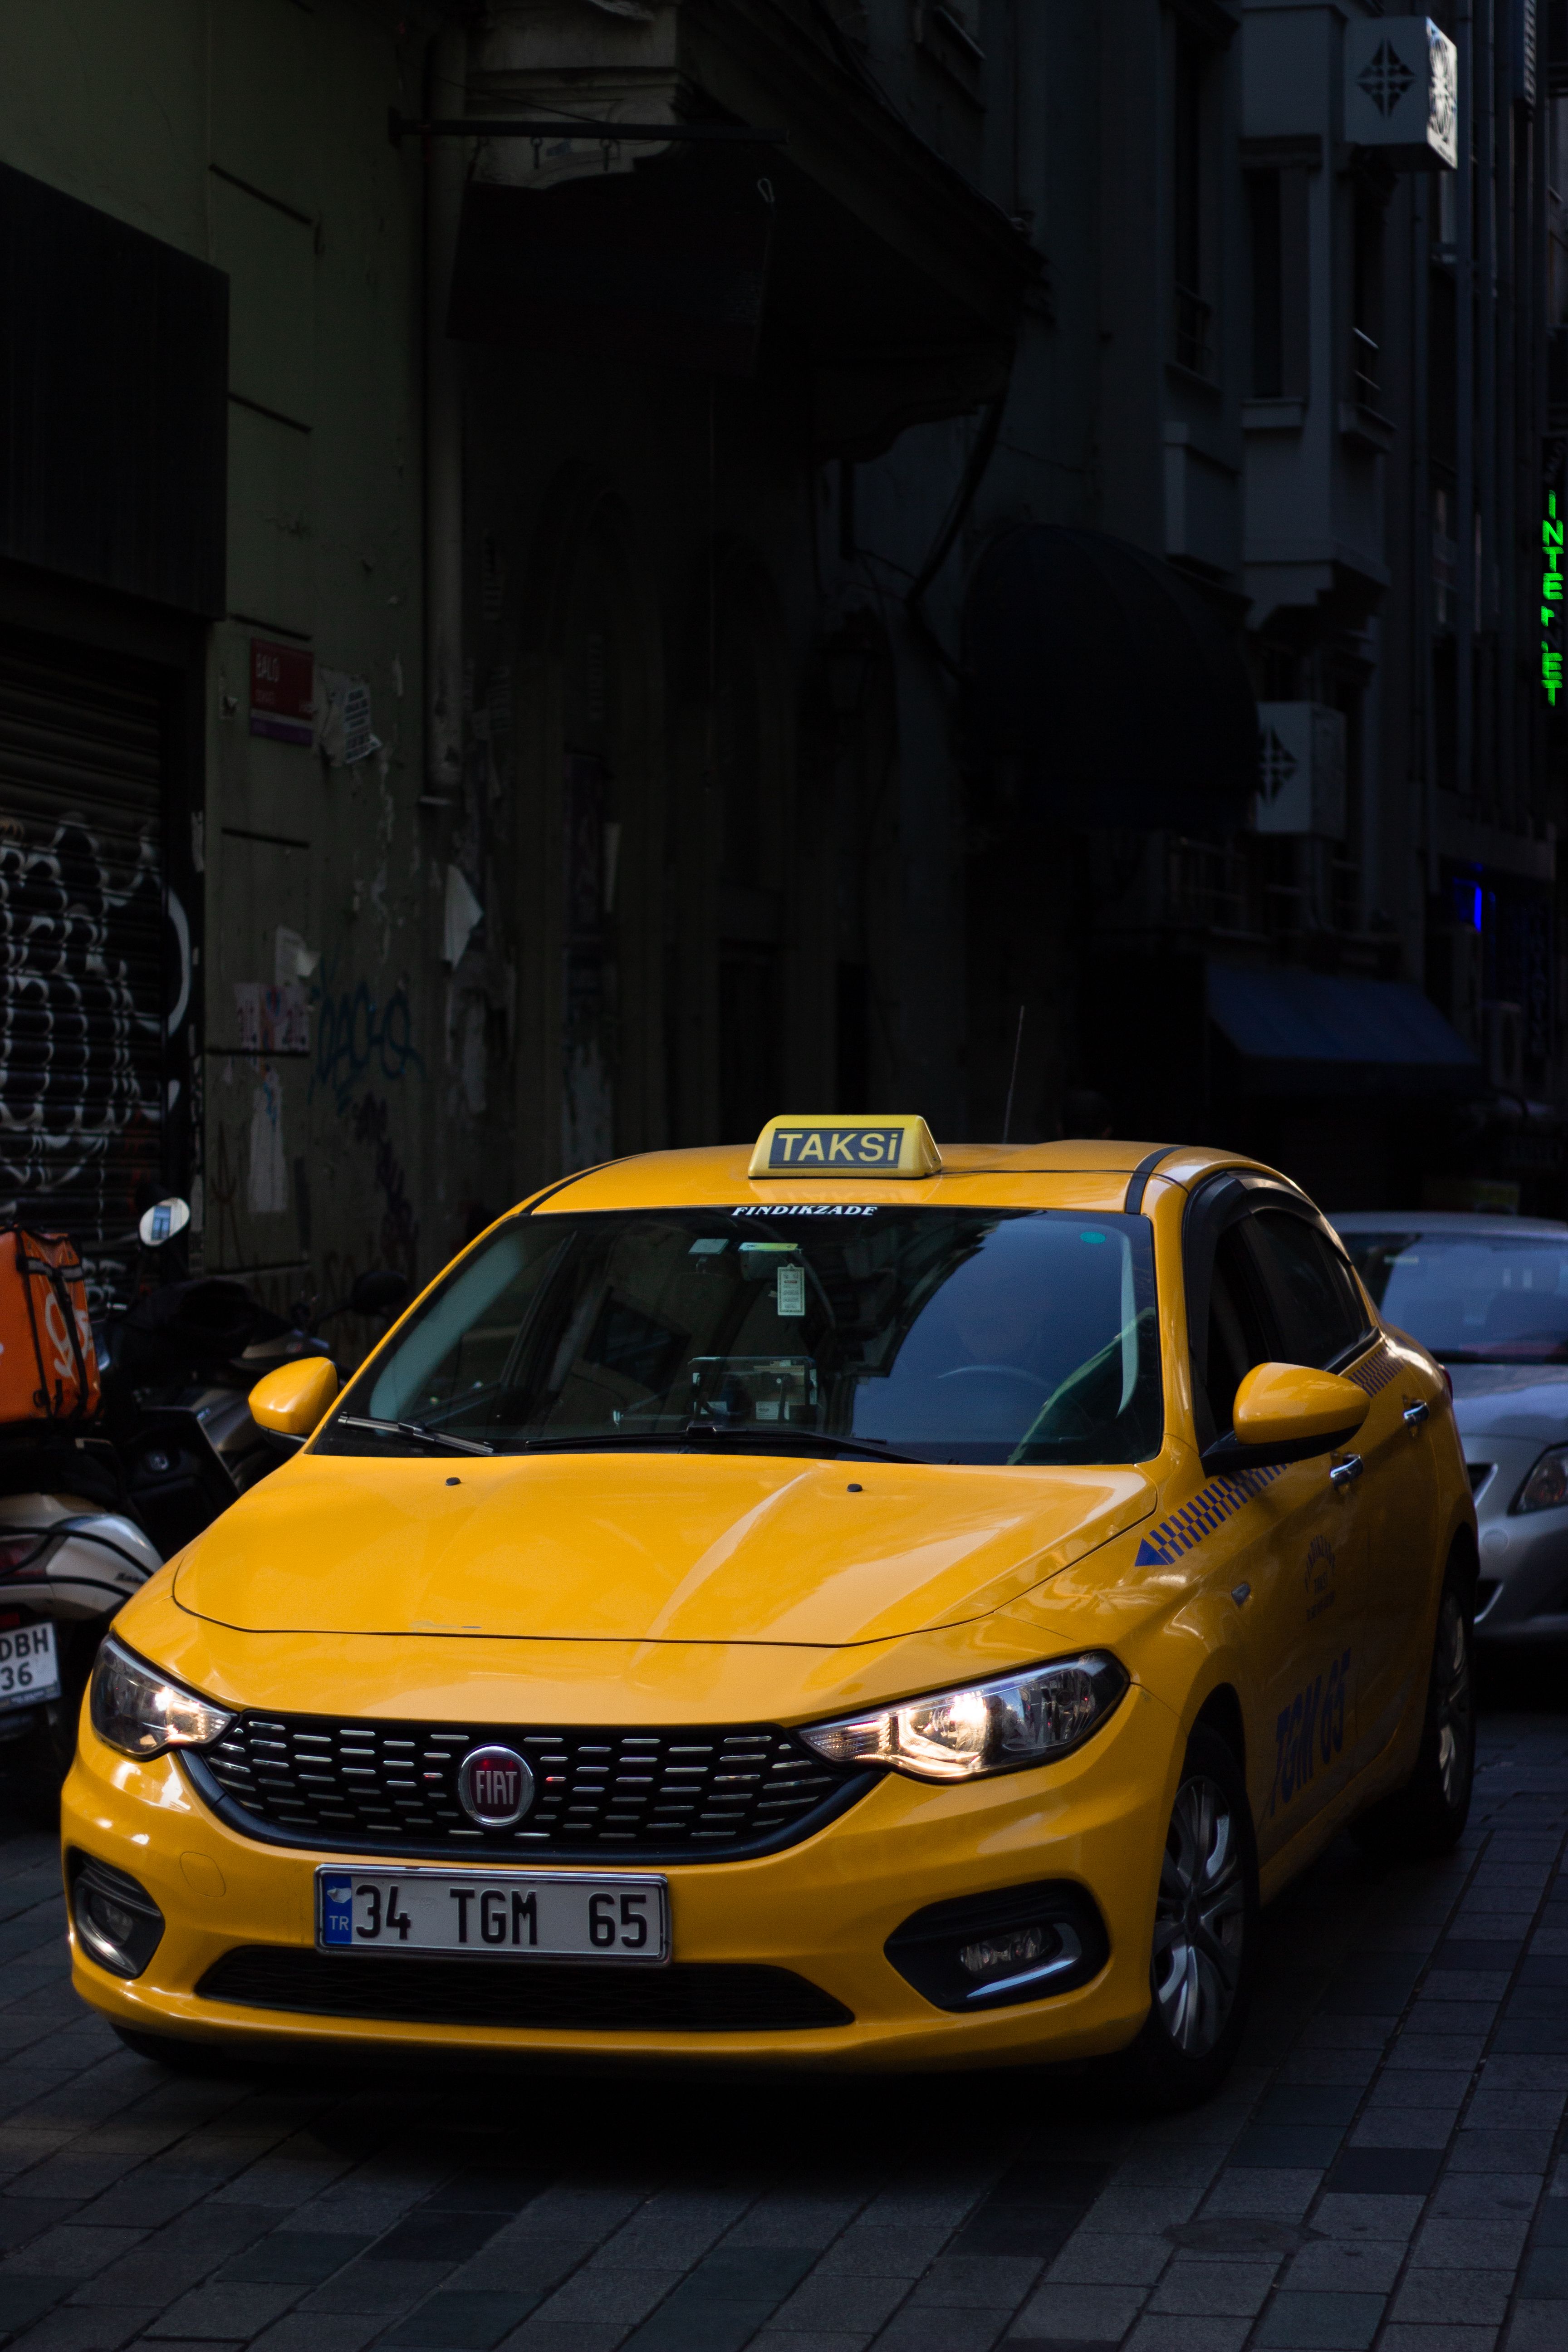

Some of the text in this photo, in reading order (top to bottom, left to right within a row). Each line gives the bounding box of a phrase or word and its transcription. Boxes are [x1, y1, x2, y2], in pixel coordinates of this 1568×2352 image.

[0, 1661, 33, 1690] 36
[1270, 1675, 1322, 1818] TGM
[1320, 1647, 1352, 1764] 65
[476, 1770, 518, 1805] FIAT
[328, 1914, 349, 1931] TR
[356, 1884, 647, 1948] 34 TGM 65
